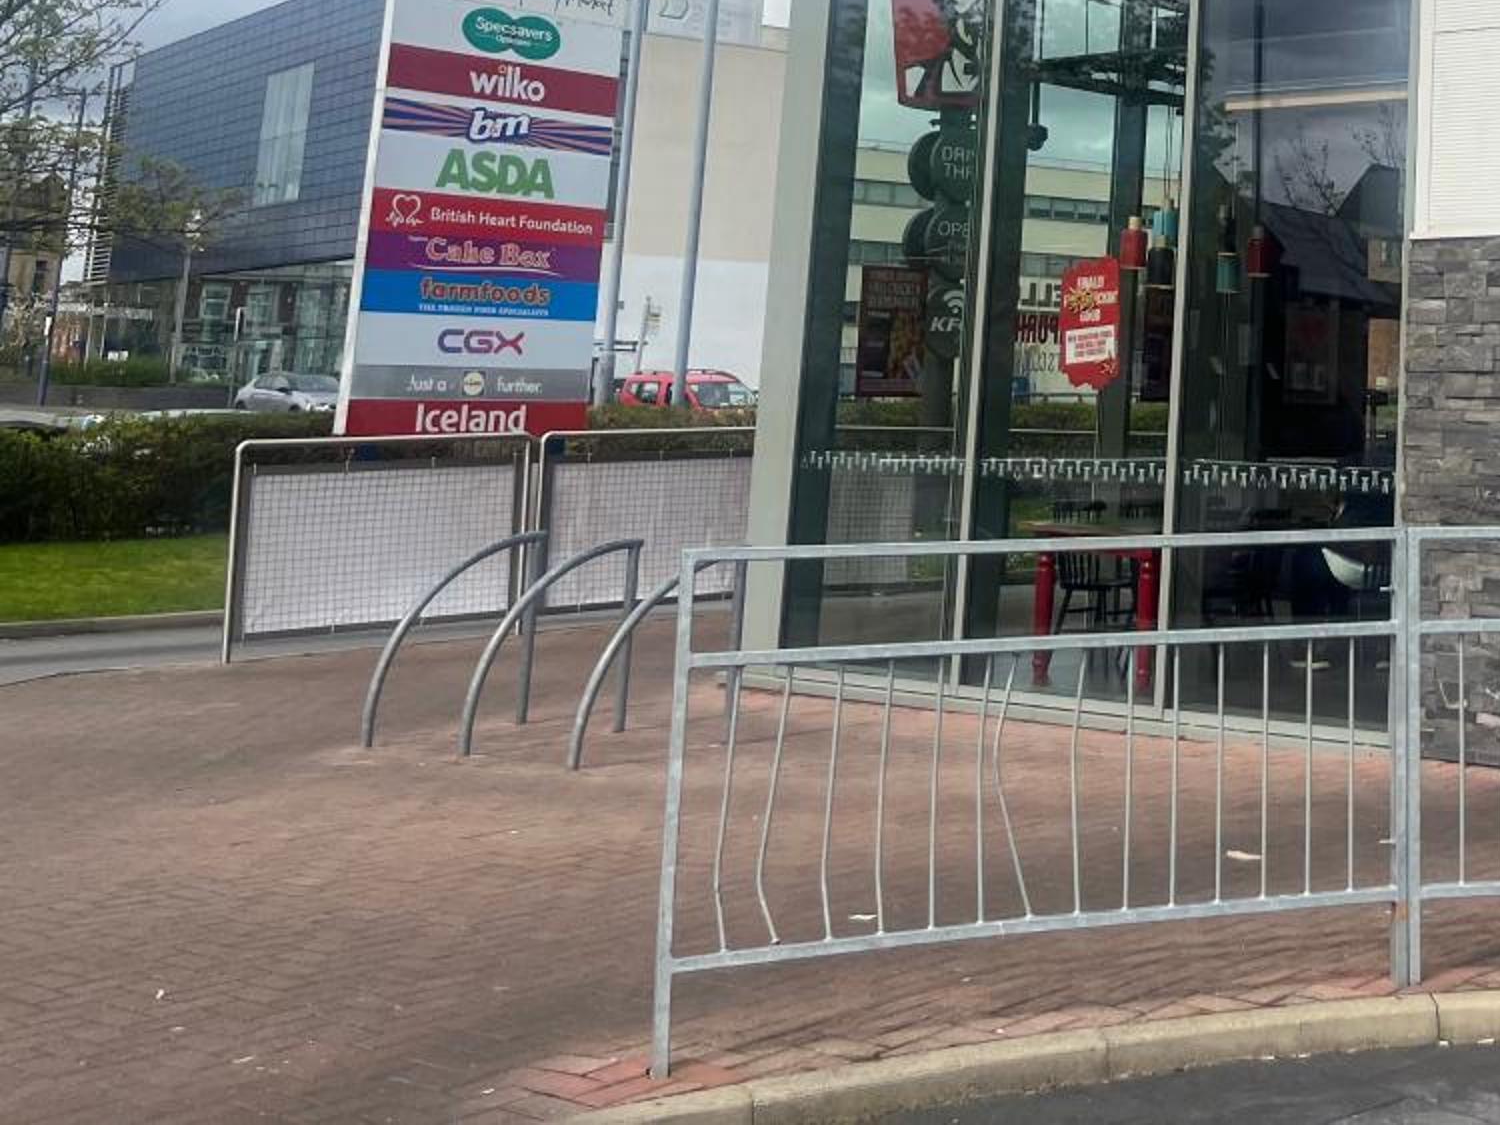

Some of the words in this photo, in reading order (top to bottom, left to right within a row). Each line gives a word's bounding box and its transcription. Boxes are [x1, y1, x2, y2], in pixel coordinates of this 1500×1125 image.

[475, 15, 553, 42] Specsavers
[469, 64, 545, 102] wilko
[435, 148, 555, 199] ASDA
[430, 206, 475, 224] British
[479, 211, 516, 228] Heart
[519, 215, 593, 236] Foundation
[425, 236, 495, 264] Cake
[499, 242, 551, 269] Box
[420, 276, 549, 306] farmfoods
[437, 328, 525, 355] CGX
[415, 402, 527, 433] Iceland
